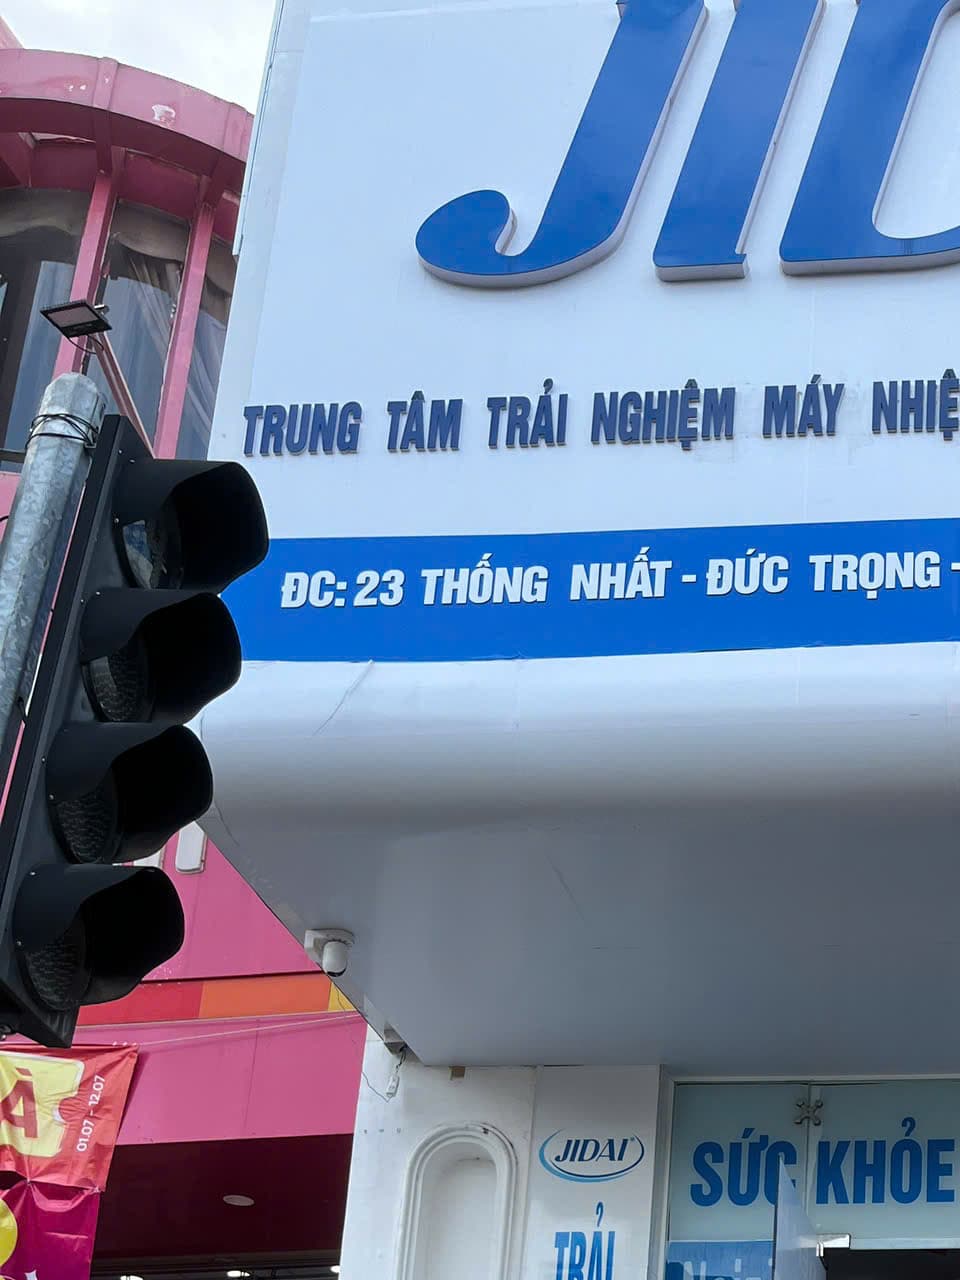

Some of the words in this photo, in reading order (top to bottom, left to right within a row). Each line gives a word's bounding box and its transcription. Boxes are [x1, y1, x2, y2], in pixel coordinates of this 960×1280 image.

[243, 401, 362, 456] TRUNG
[387, 390, 463, 451] TÂM
[487, 378, 569, 448] TRẢI
[591, 379, 736, 451] NGHIỆM
[762, 374, 844, 439] MÁY
[281, 570, 346, 608] ĐC:
[353, 568, 405, 607] 23
[421, 553, 548, 606] THỐNG
[570, 546, 672, 601] NHẤT
[706, 548, 789, 596] ĐỨC
[809, 551, 940, 600] TRỌNG
[76, 1119, 95, 1152] 01.07
[88, 1074, 105, 1107] 12.07
[554, 1138, 630, 1162] JIDAI
[690, 1127, 797, 1206] SỨC
[816, 1117, 956, 1205] KHỎE
